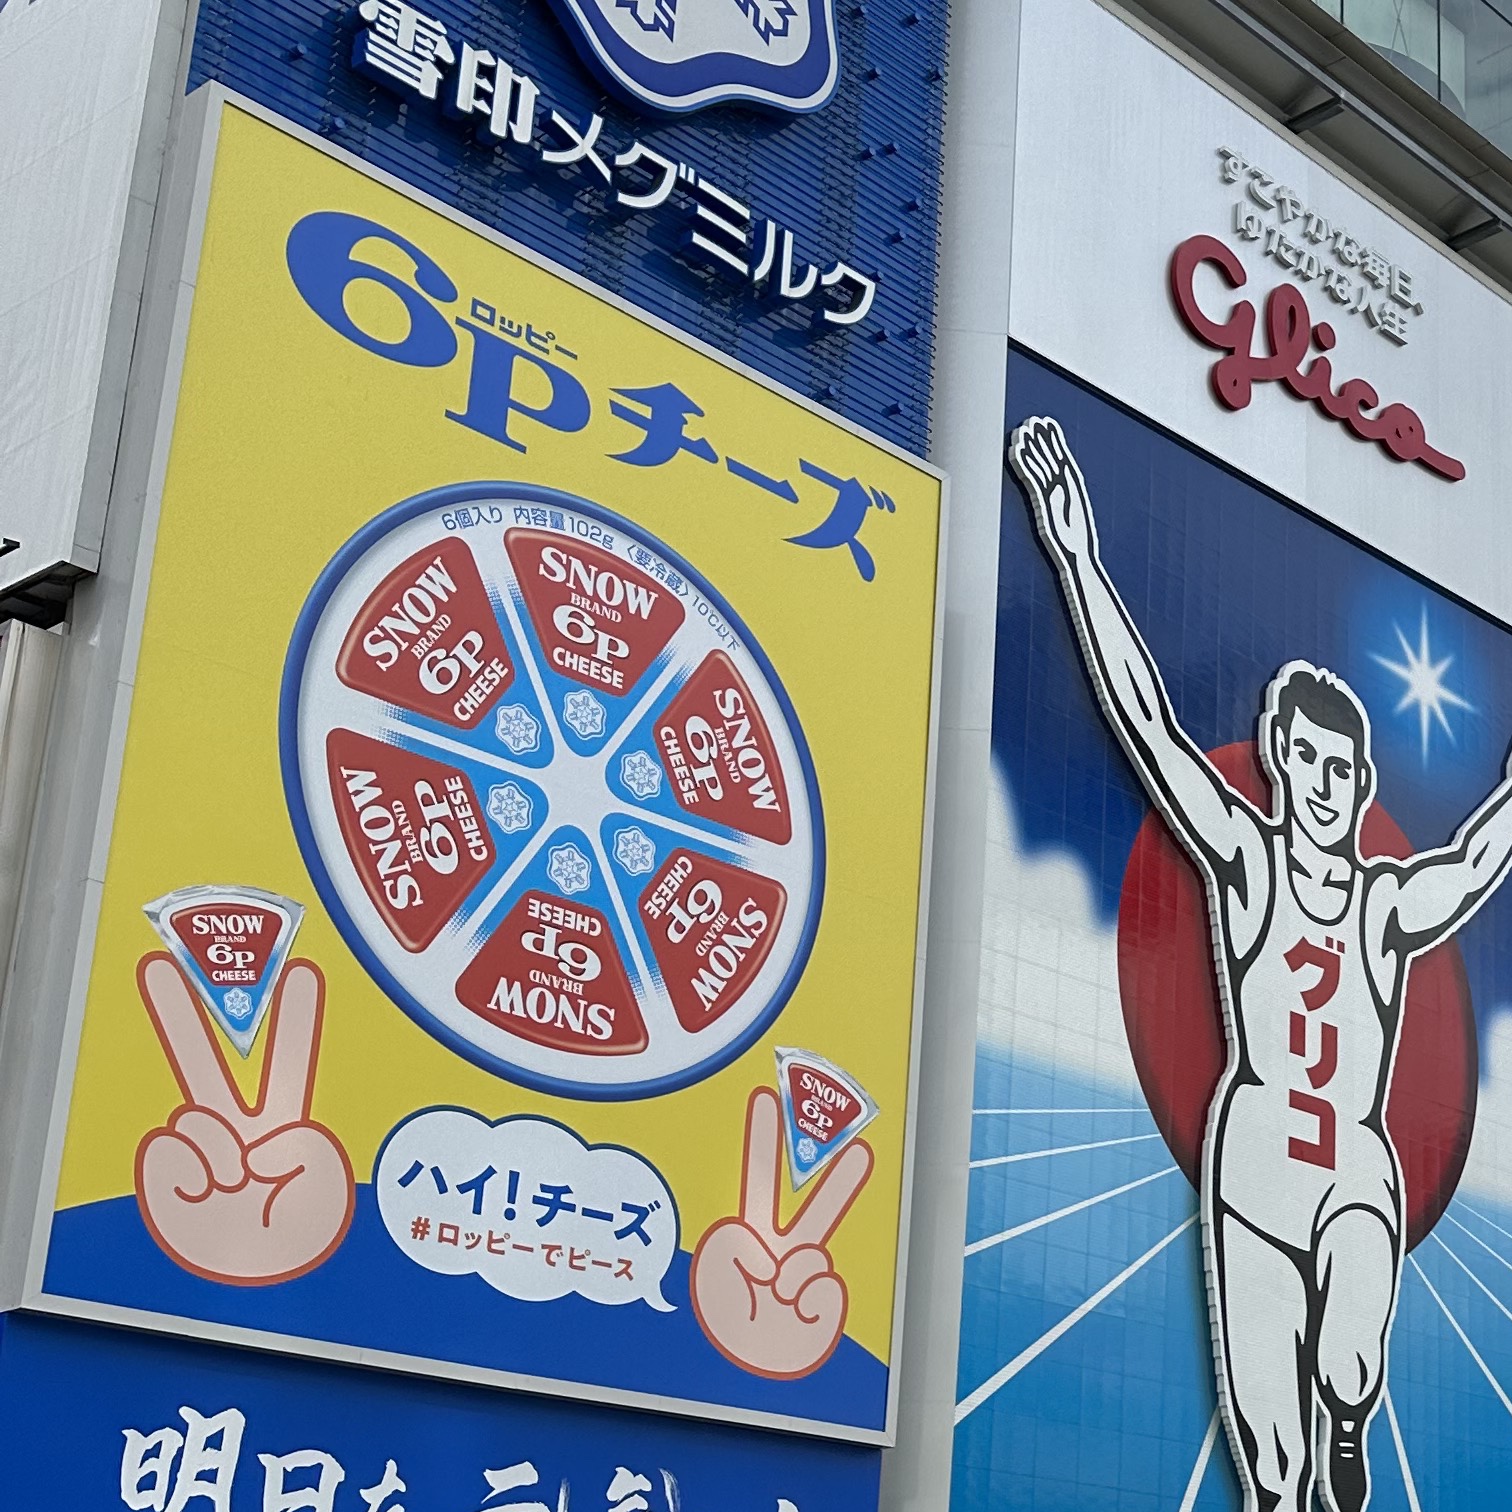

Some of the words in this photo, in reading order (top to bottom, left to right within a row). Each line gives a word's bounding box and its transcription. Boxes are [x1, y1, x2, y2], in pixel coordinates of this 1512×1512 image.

[358, 0, 877, 325] 雪印メグミルク
[1231, 200, 1409, 347] ゆたかな人生
[471, 299, 578, 360] ロッピー
[1170, 234, 1466, 483] Glico
[363, 556, 459, 671] SNOW
[538, 545, 659, 620] SNOW
[570, 592, 622, 624] BRAND
[410, 613, 452, 660] BRAND
[418, 629, 487, 696] 6P
[553, 603, 630, 664] 6P
[452, 657, 509, 722] CHEESE
[553, 646, 623, 689] CHEESE
[659, 725, 700, 804] CHEESE
[684, 716, 723, 802] 6P
[714, 687, 781, 816] SNOW
[714, 726, 742, 784] BRAND
[340, 766, 423, 911] SNOW
[391, 800, 423, 864] BRAND
[420, 779, 459, 876] 6P
[444, 775, 488, 862] CHEESE
[527, 897, 602, 938] CHEESE
[642, 855, 692, 919] CHEESE
[665, 878, 722, 945] 6P
[193, 914, 264, 935] SNOW
[207, 943, 255, 969] 6P
[520, 923, 603, 981] 6P
[690, 897, 769, 1013] SNOW
[695, 911, 730, 957] BRAND
[211, 970, 256, 981] CHEESE
[487, 975, 617, 1040] SNOW
[528, 970, 584, 995] BRAND
[1283, 936, 1345, 1171] グリコ
[800, 1072, 851, 1112] SNOW
[801, 1100, 833, 1128] 6P
[410, 1216, 634, 1282] #ロッピーでピース
